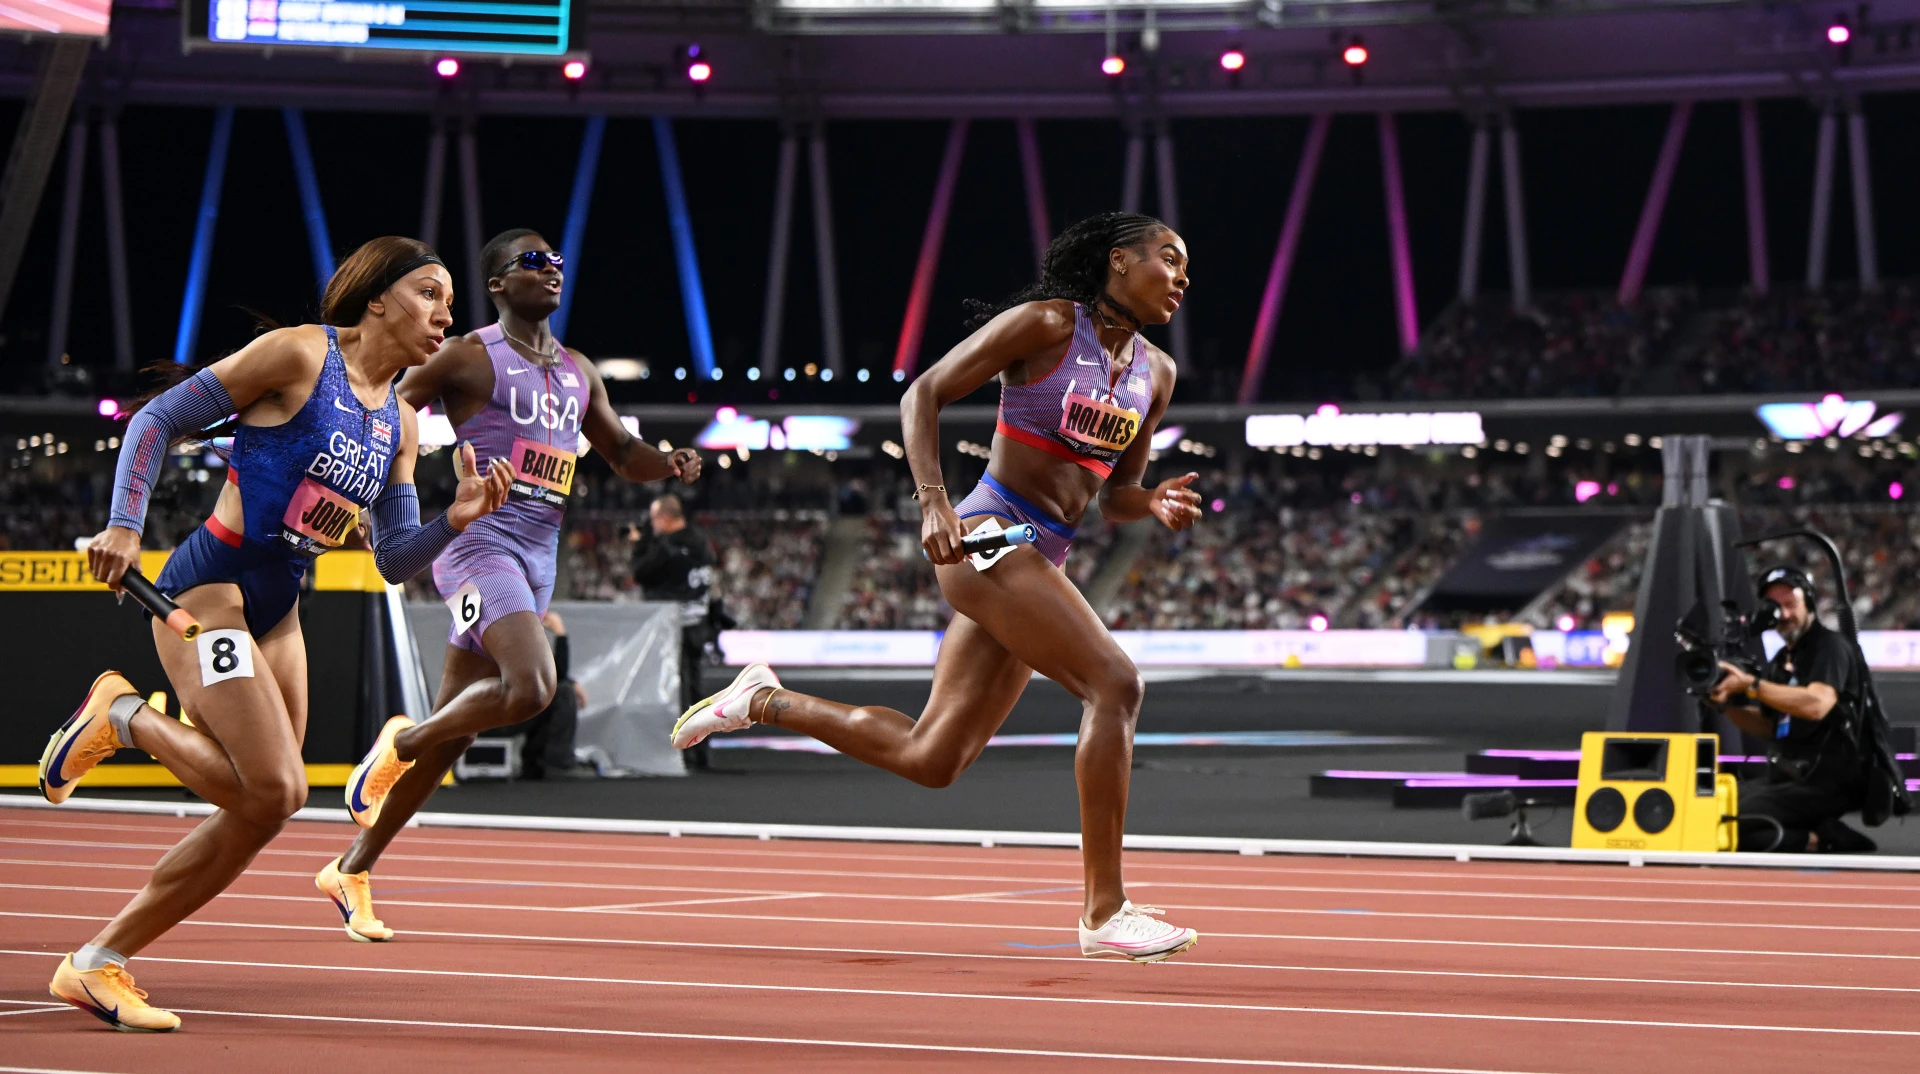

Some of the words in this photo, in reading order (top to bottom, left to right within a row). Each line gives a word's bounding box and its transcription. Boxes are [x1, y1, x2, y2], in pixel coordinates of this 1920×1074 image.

[510, 386, 579, 433] USA
[1065, 402, 1134, 445] HOLMES
[329, 431, 386, 479] GREAT
[520, 448, 574, 487] BAILEY
[308, 453, 384, 504] BRITAIN
[301, 496, 356, 541] JOHN
[0, 558, 99, 584] SEIK
[461, 593, 476, 623] 6
[211, 637, 240, 674] 8
